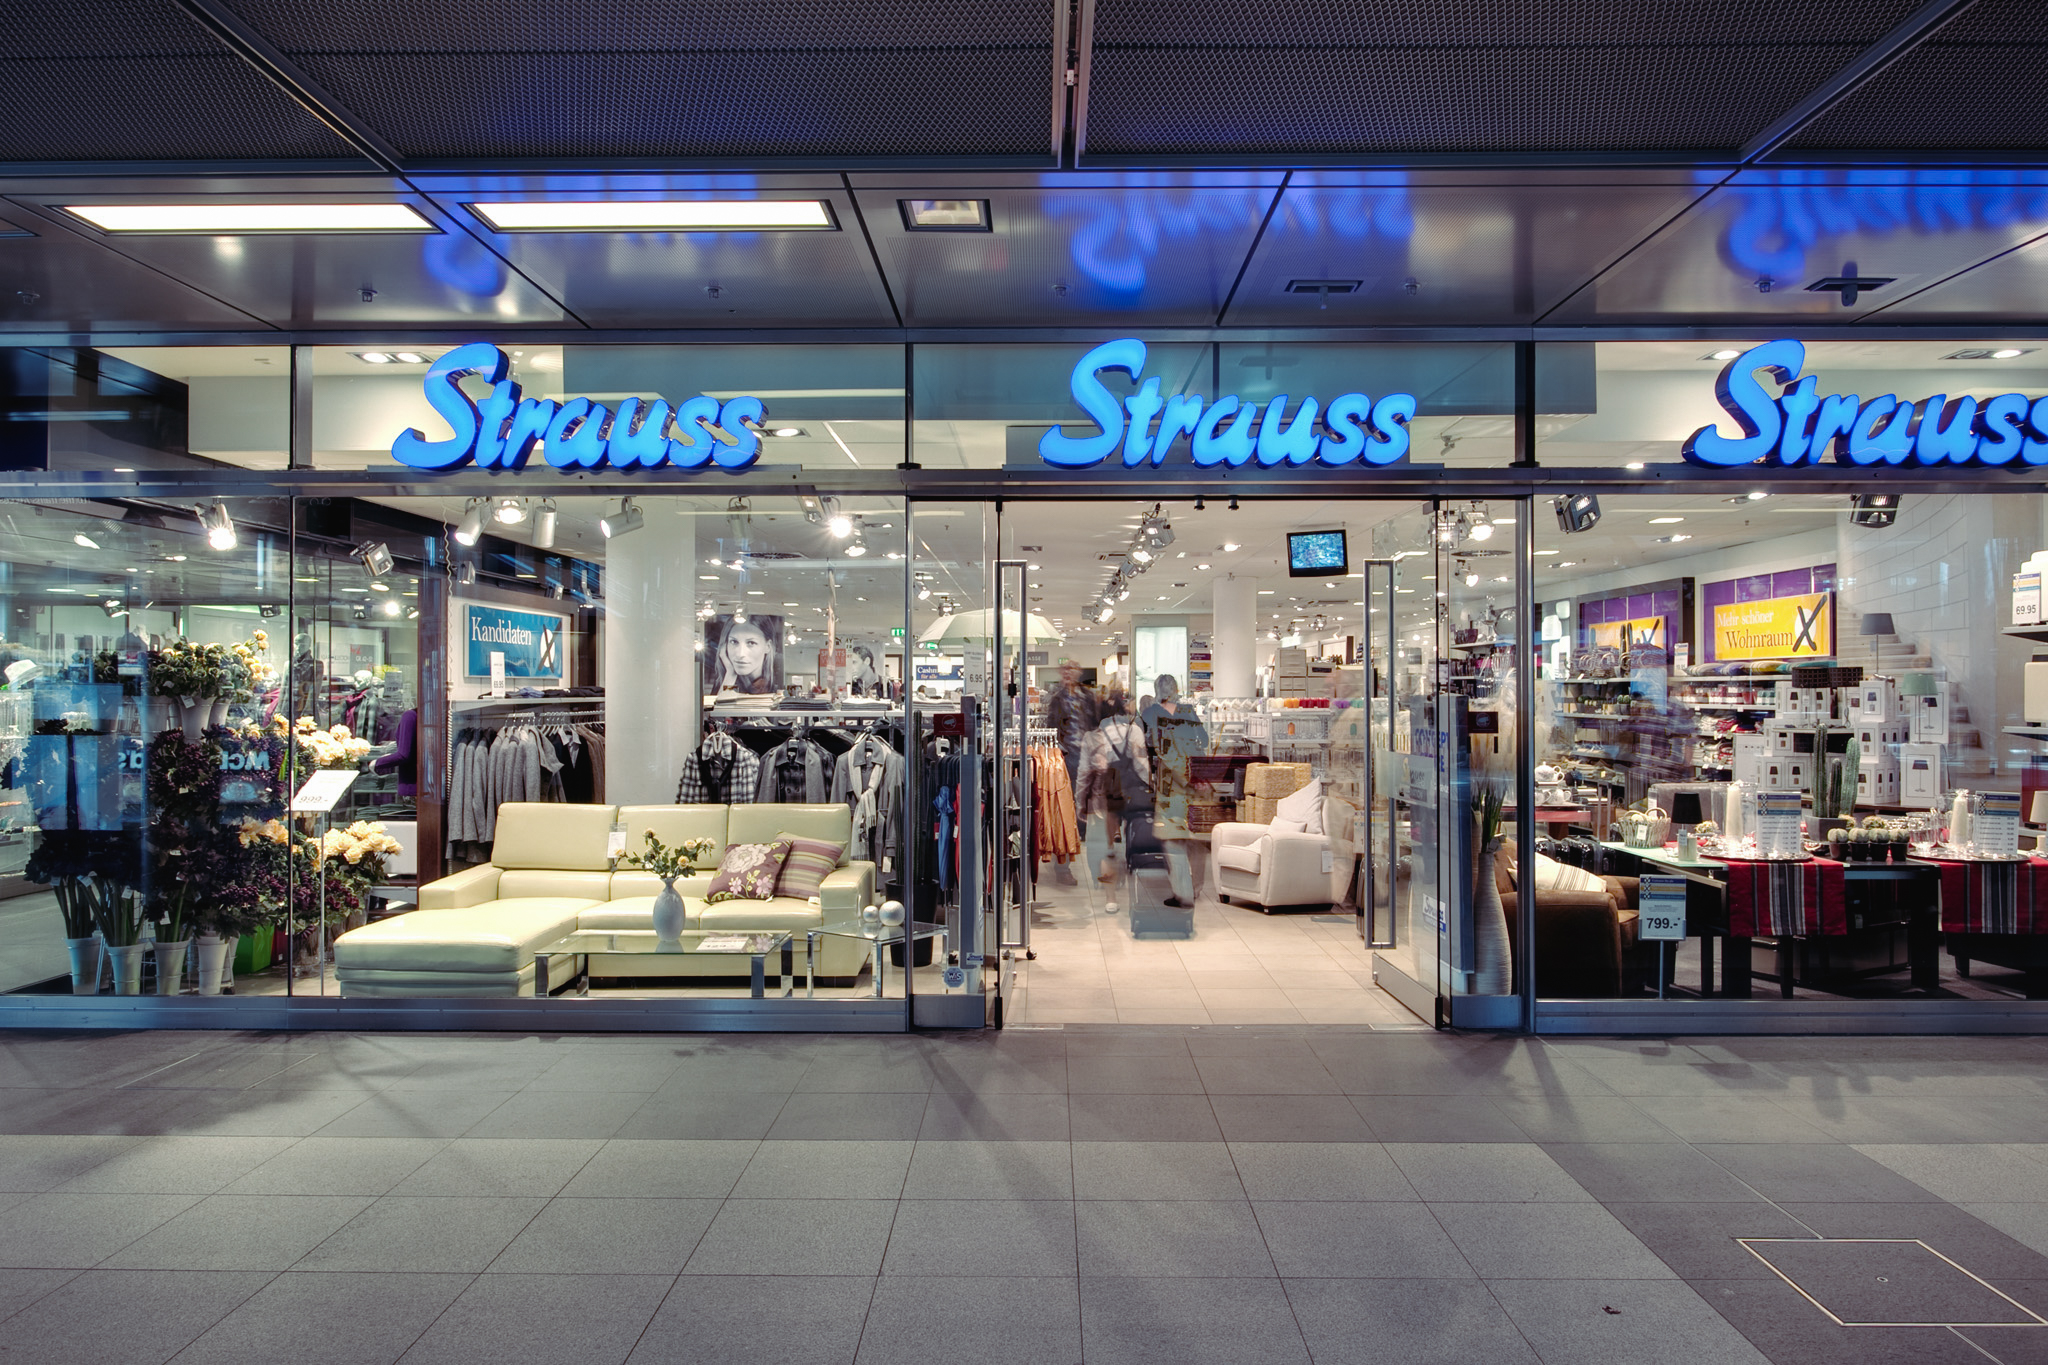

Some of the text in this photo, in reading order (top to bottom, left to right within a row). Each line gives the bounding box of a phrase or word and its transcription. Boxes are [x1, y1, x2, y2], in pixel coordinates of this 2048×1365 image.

[391, 342, 768, 470] Strauss
[1038, 338, 1417, 468] Strauss
[1717, 610, 1774, 628] Mehr schöner
[2016, 604, 2036, 615] 69.95
[471, 616, 532, 645] Kandidaten
[1726, 629, 1793, 649] Wohnraum
[969, 674, 983, 683] 6.95
